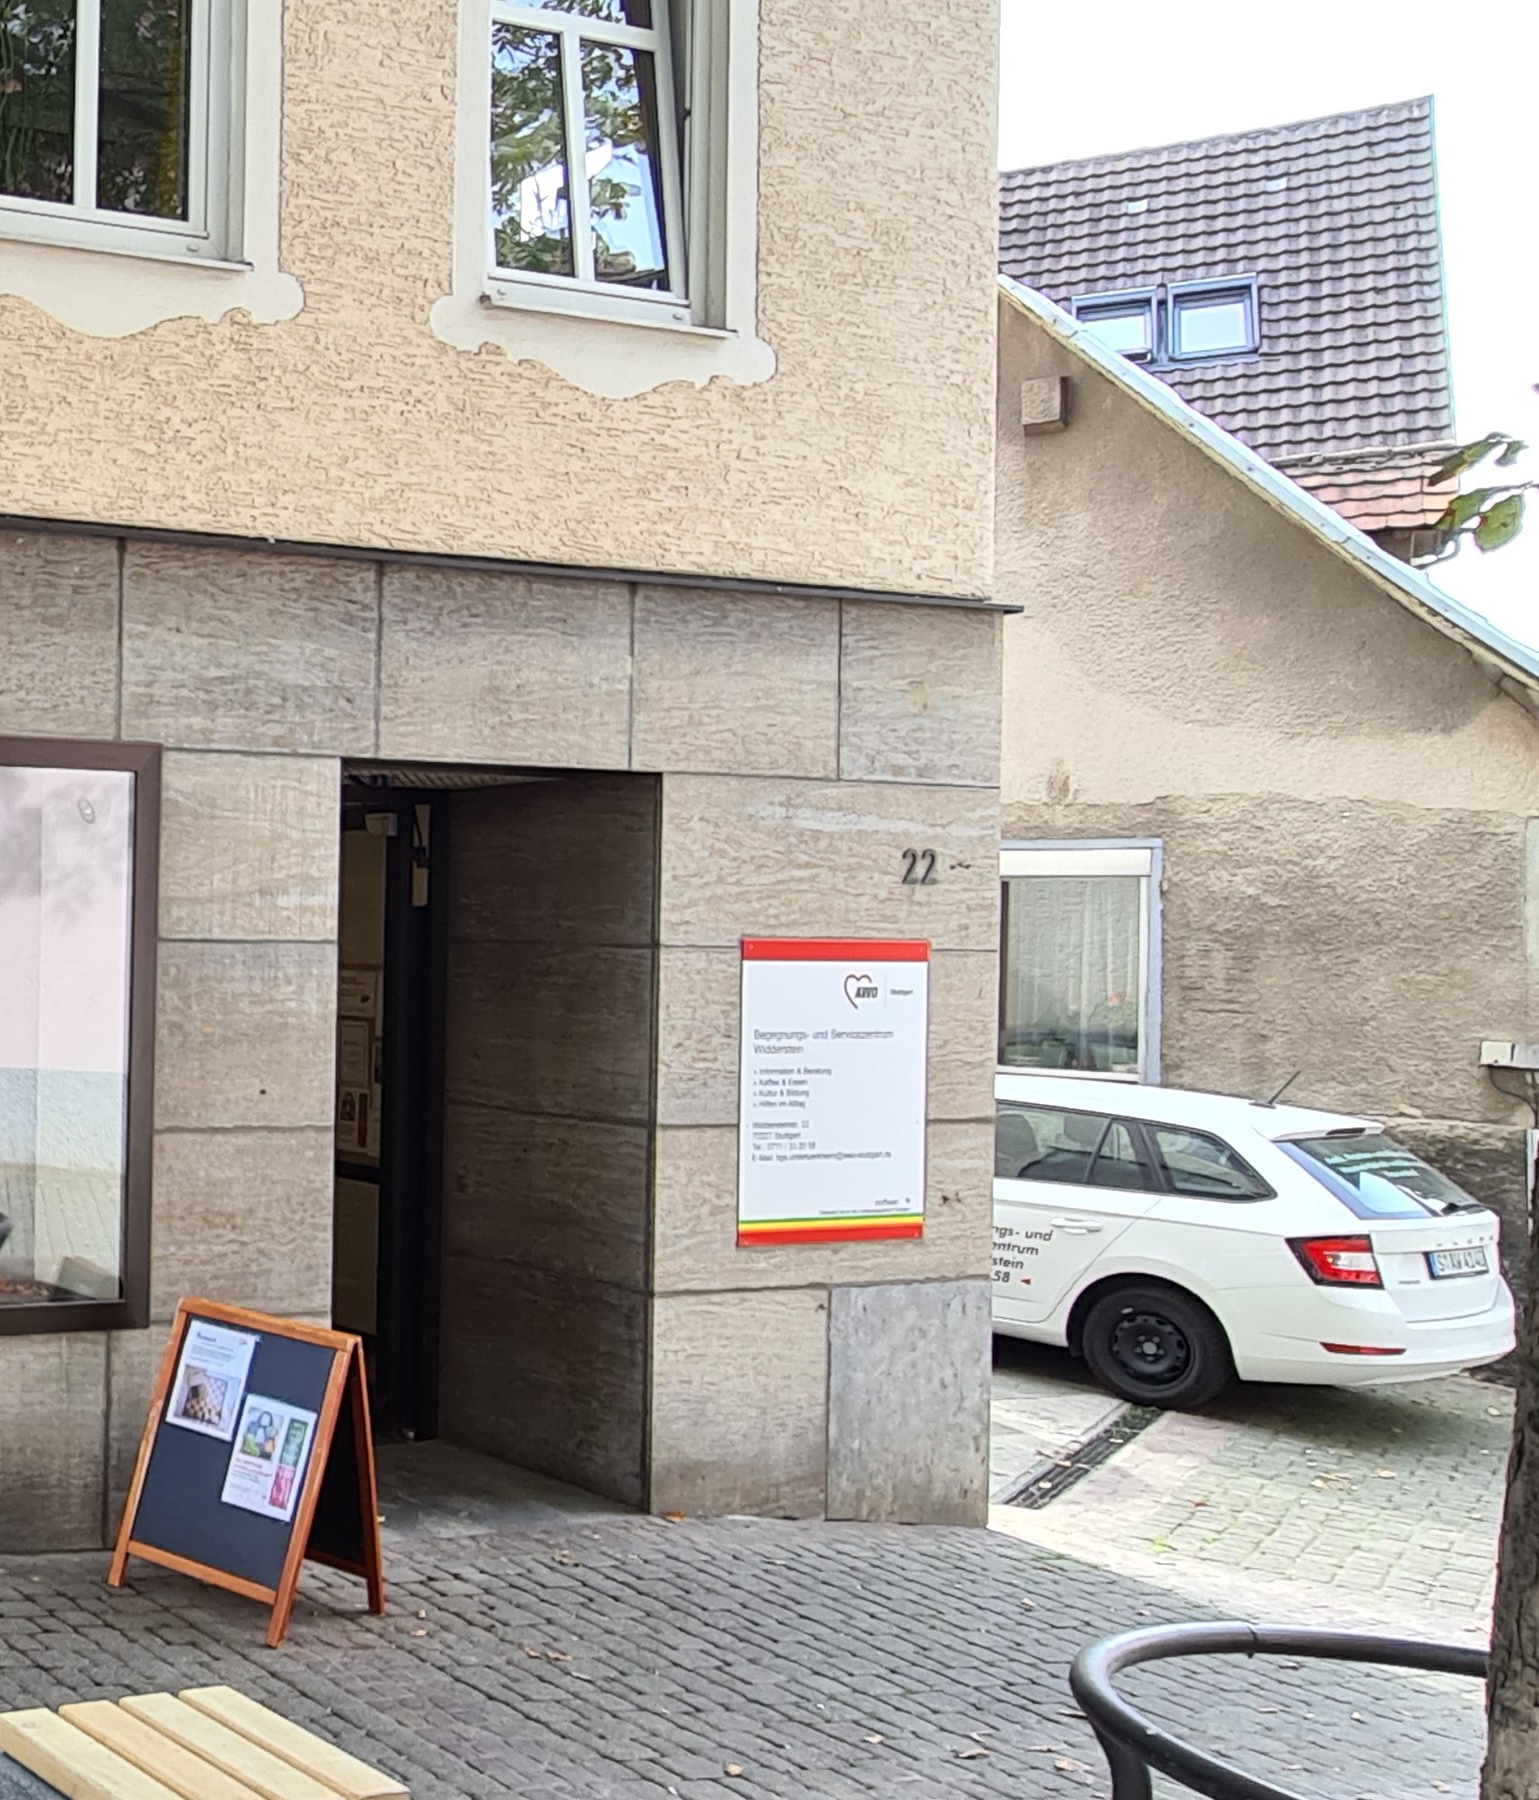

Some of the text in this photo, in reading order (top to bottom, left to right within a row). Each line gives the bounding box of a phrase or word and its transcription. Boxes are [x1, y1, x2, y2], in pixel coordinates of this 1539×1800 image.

[902, 847, 938, 885] 22
[854, 986, 878, 999] AWO
[753, 1028, 894, 1042] Begegnungs- und Servicezentrum
[753, 1044, 804, 1055] Widderstein
[1025, 1229, 1053, 1241] und
